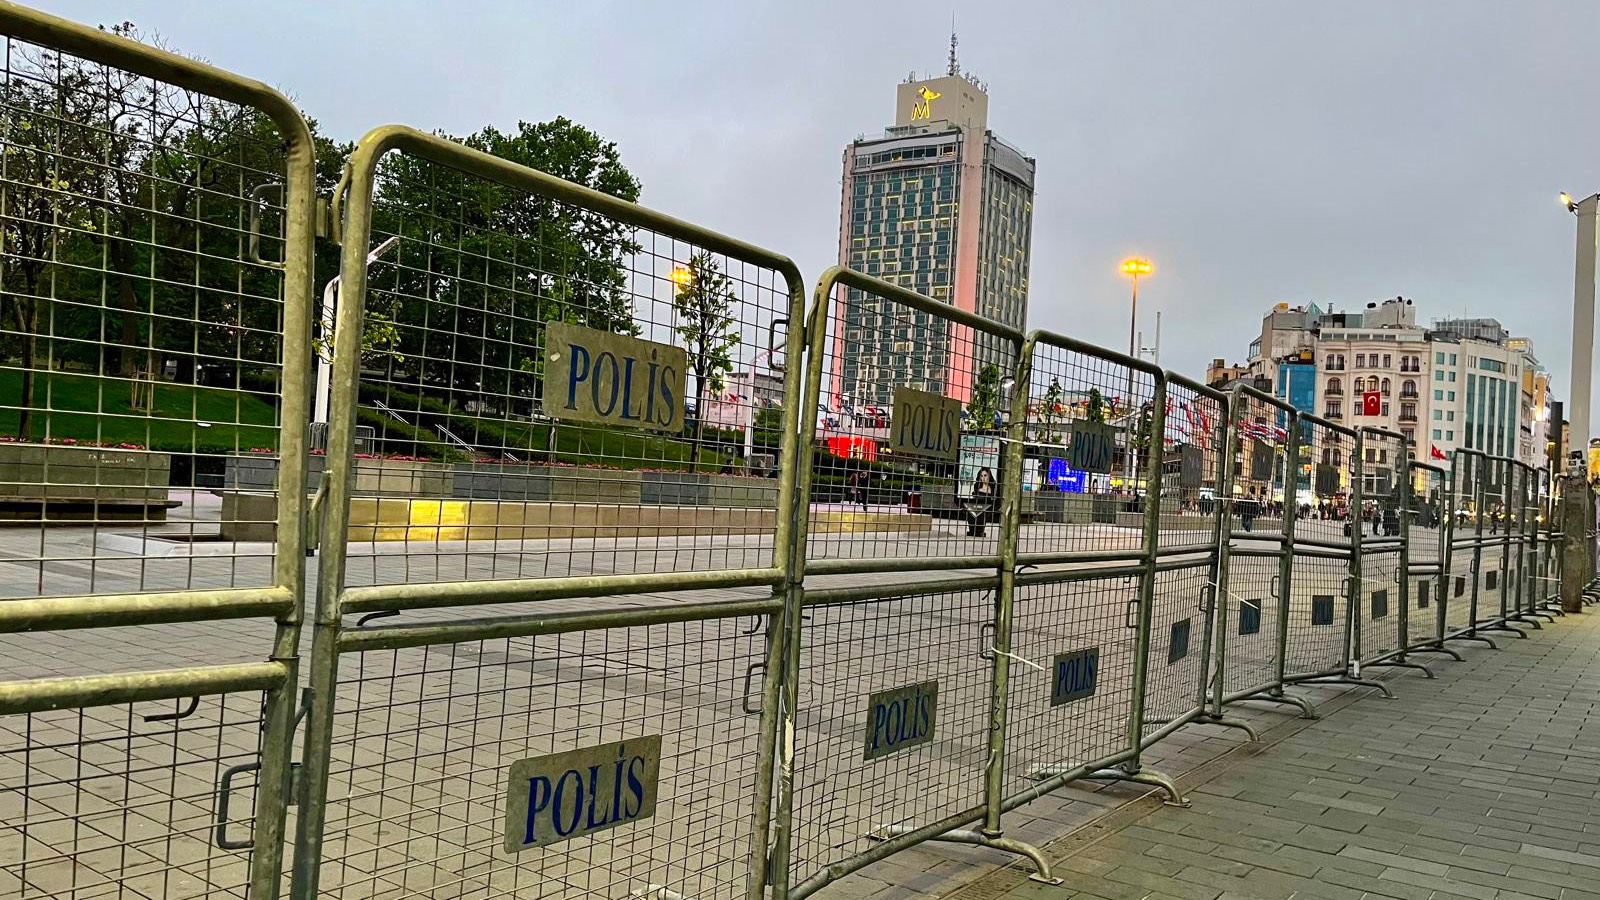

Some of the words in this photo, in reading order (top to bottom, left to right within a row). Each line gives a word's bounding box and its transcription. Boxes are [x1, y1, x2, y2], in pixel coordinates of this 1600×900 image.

[564, 343, 676, 427] POLİS
[899, 399, 954, 454] POLİS
[1057, 650, 1095, 697] POLİS
[872, 687, 930, 750] POLİS
[522, 743, 646, 845] POLİS
